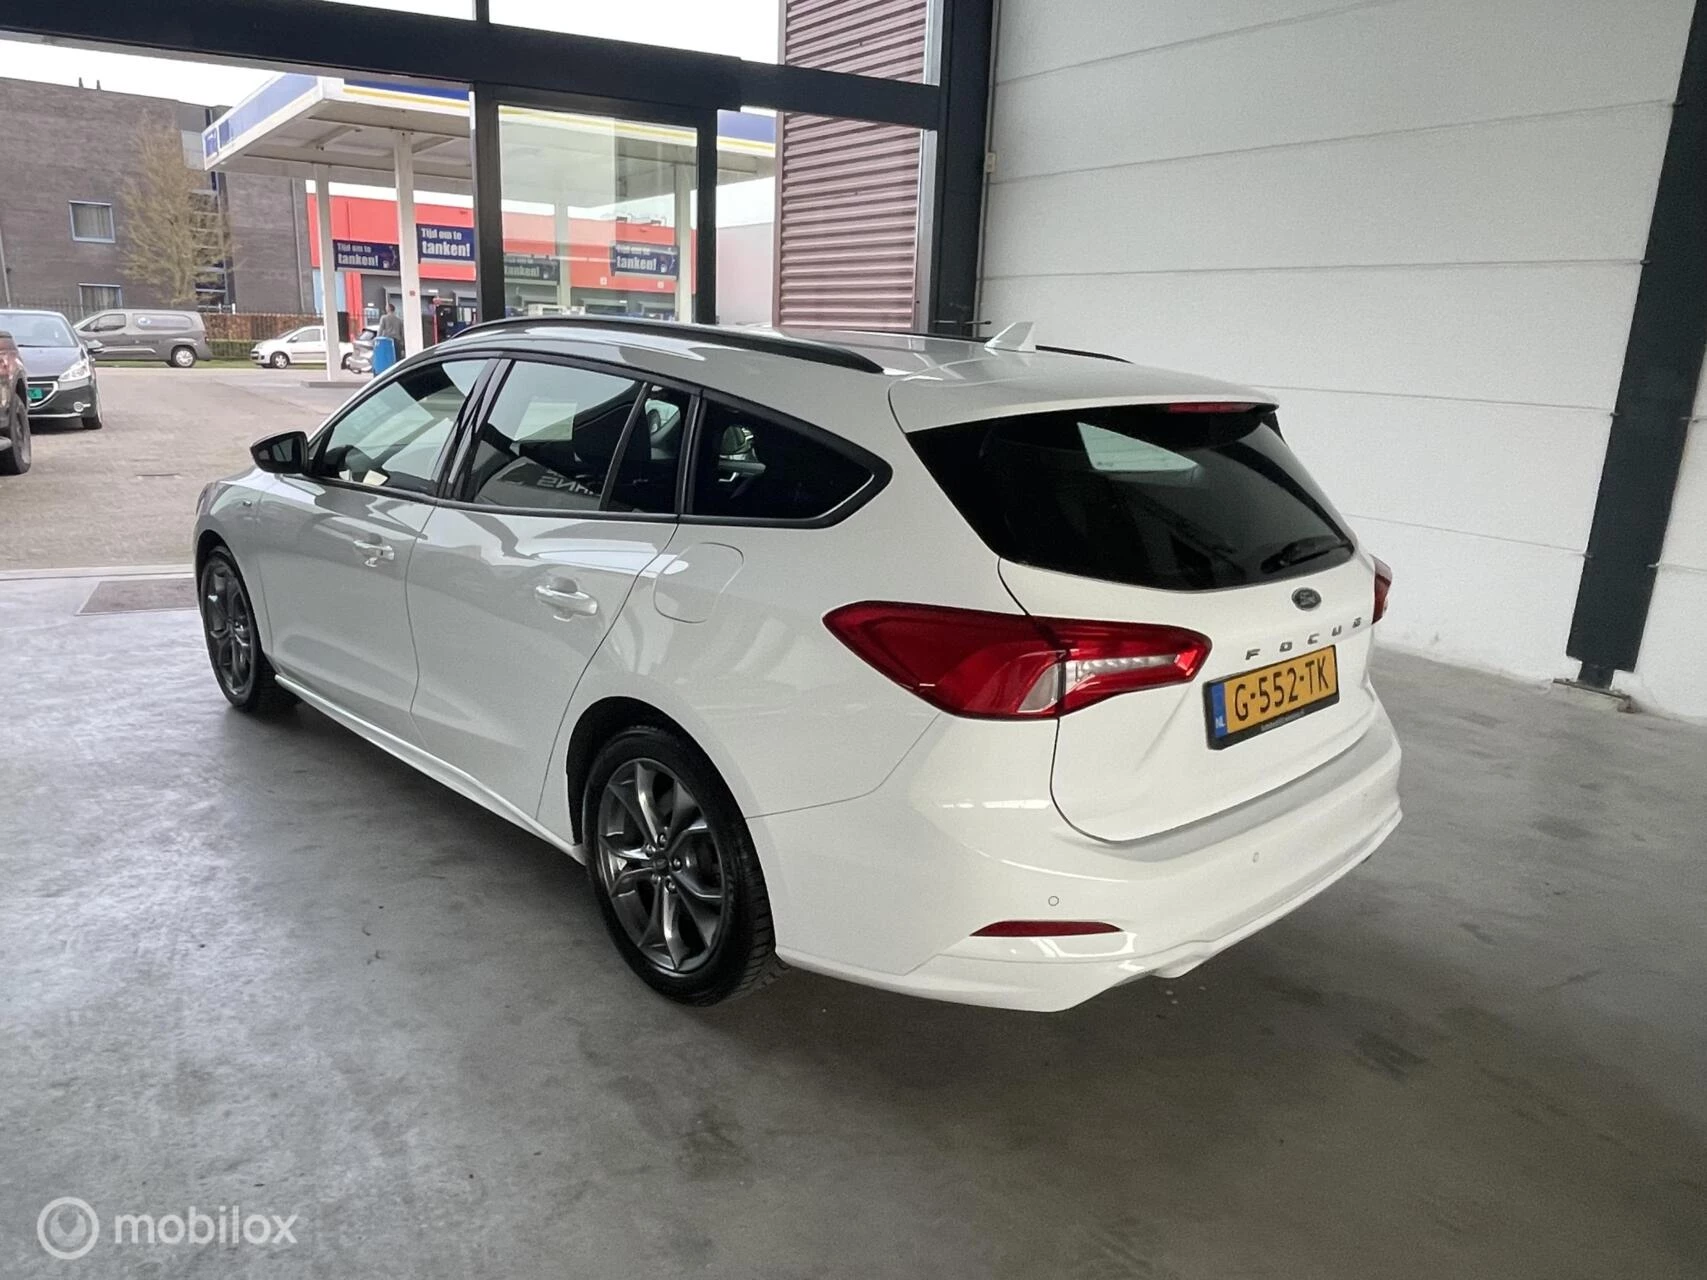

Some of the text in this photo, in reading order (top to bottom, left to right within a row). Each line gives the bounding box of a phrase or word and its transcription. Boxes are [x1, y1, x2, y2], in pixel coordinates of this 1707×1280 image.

[439, 231, 452, 240] om
[422, 241, 471, 257] tanken!
[338, 254, 379, 266] tanken!
[617, 255, 657, 271] tanken!
[1245, 617, 1362, 661] FOCUS
[1234, 655, 1330, 722] G-552-TK
